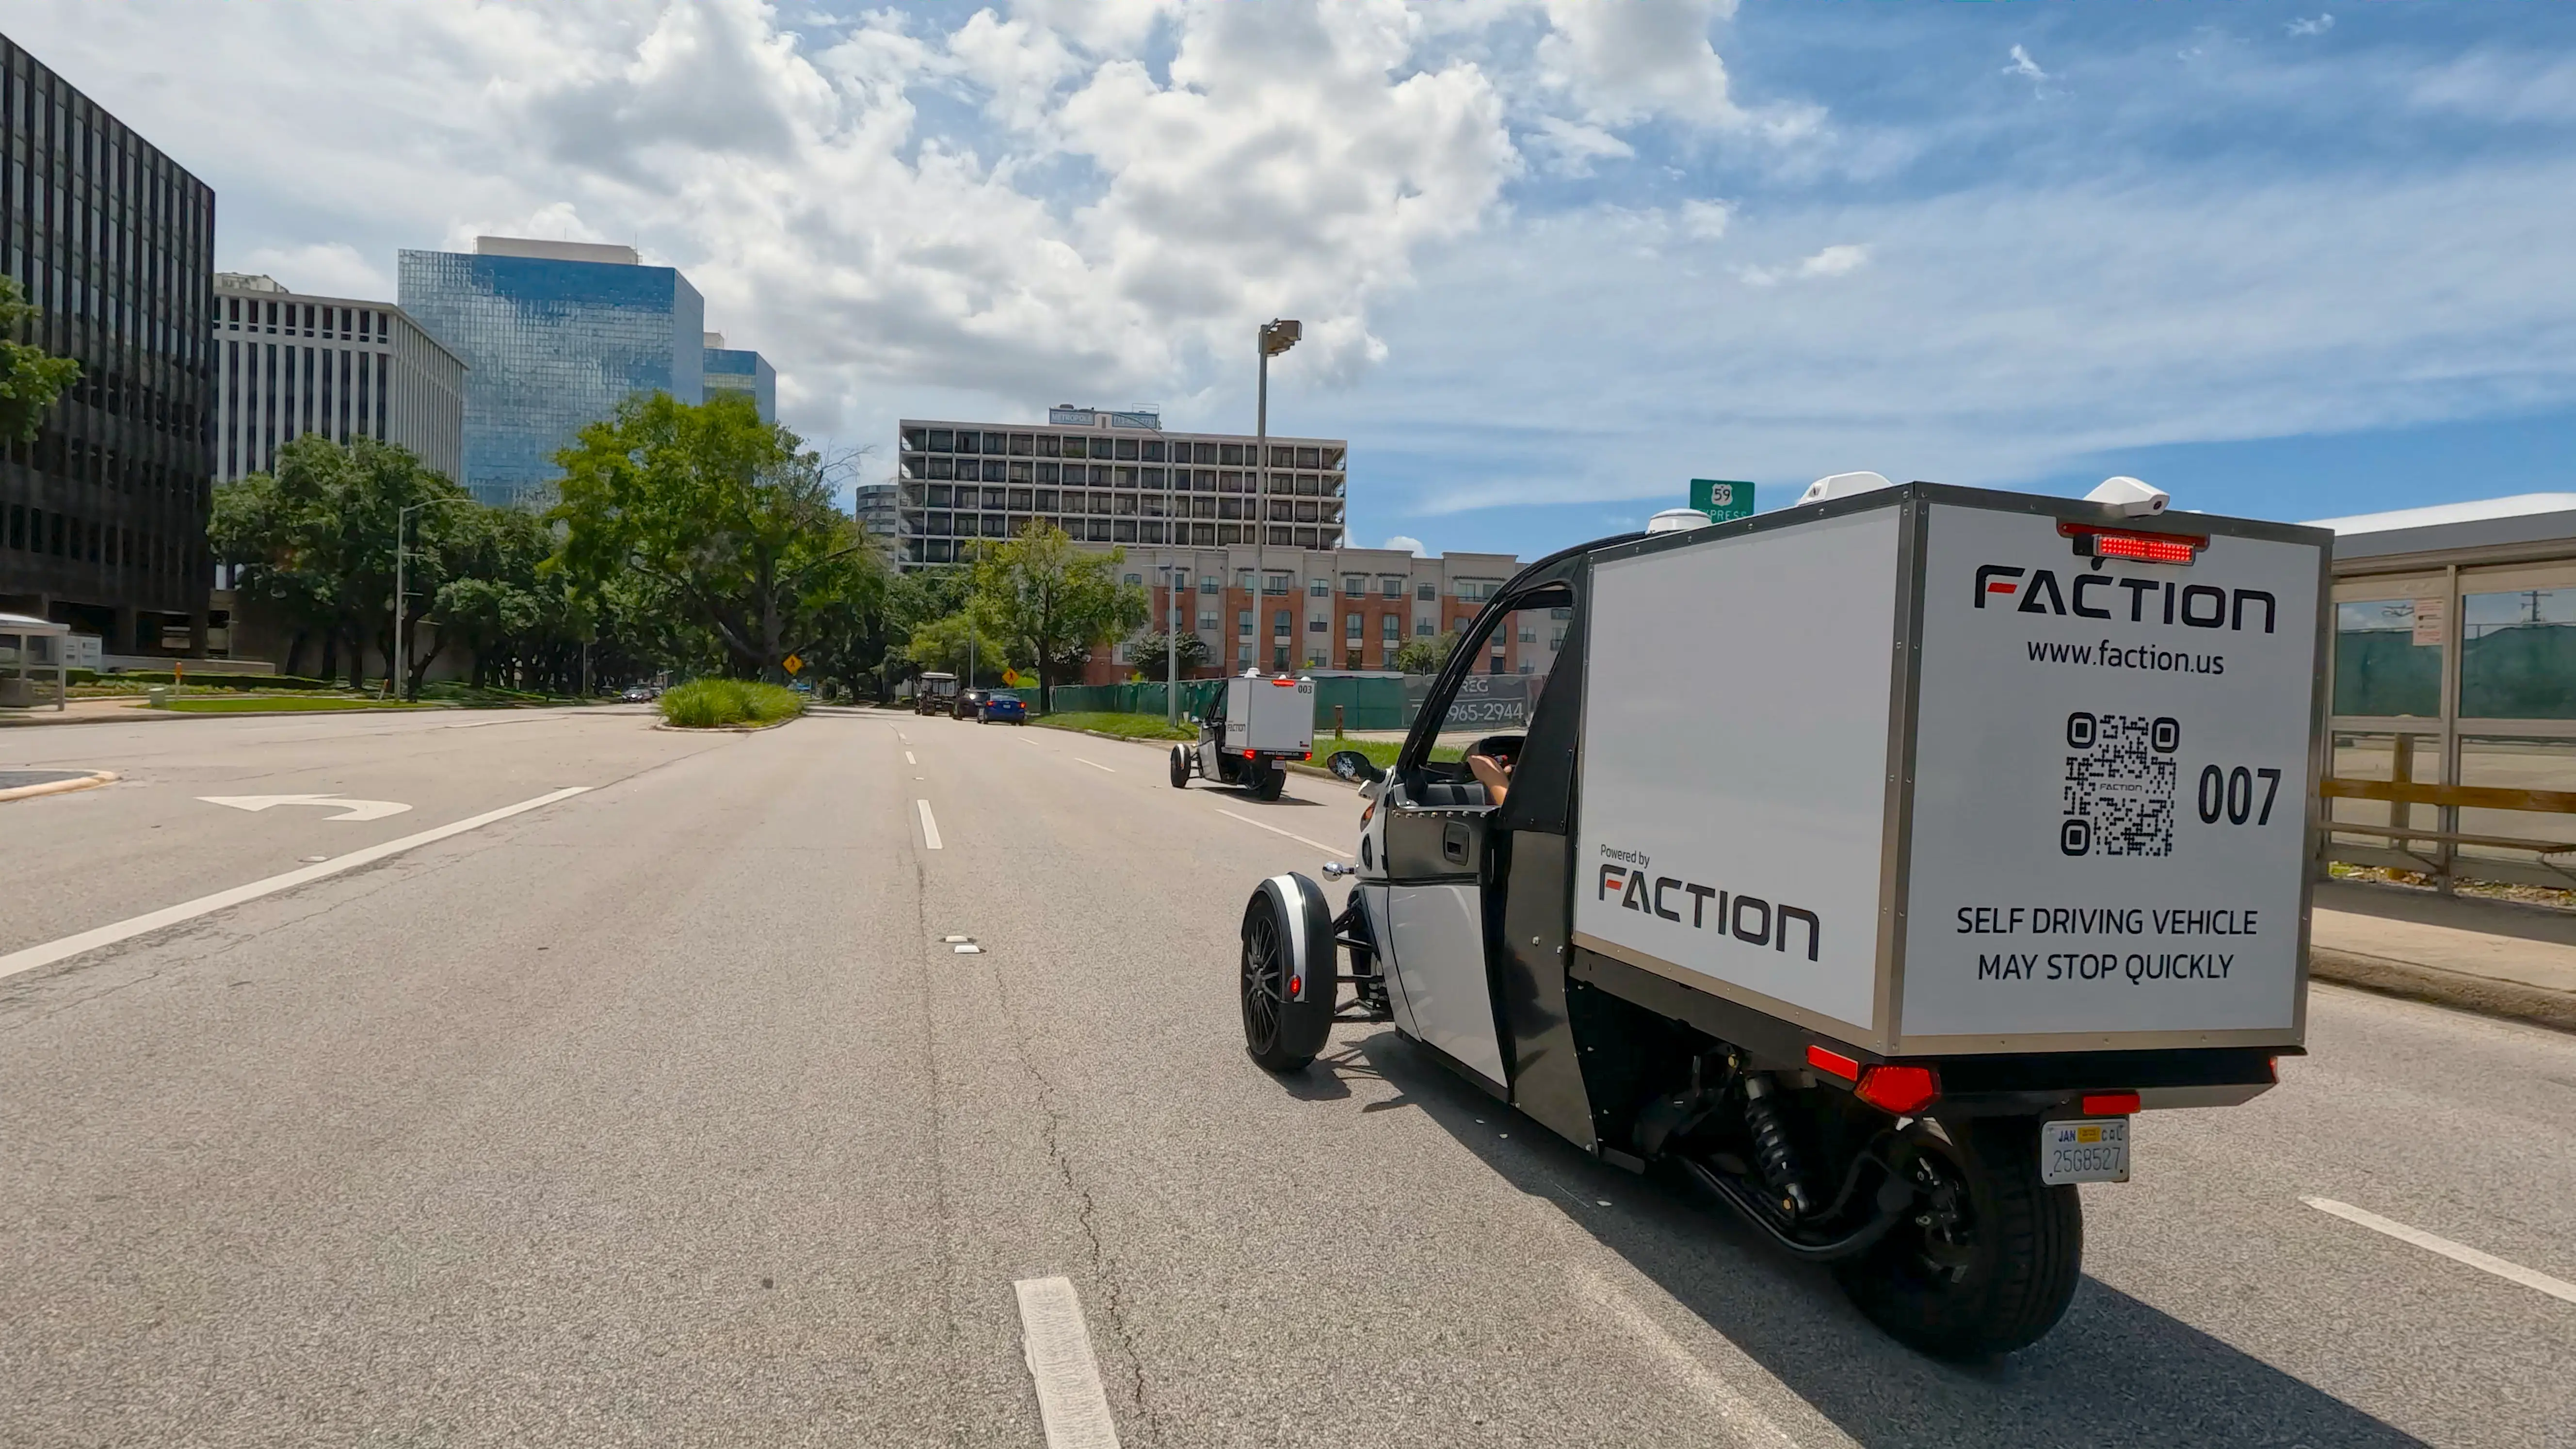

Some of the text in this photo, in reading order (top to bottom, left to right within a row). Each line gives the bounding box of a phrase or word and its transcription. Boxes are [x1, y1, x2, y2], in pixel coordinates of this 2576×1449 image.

[1714, 488, 1730, 501] 59
[1974, 564, 2275, 634] FACTION
[2028, 640, 2224, 675] www.faction.us
[1298, 685, 1312, 694] 003
[2100, 783, 2142, 791] FACTION
[2198, 764, 2281, 826] 007
[1600, 844, 1650, 869] Powered by
[1599, 864, 1820, 962] FACTION
[1957, 907, 2258, 935] SELF DRIVING VEHICLE
[1979, 954, 2234, 985] MAY STOP QUICKLY
[2058, 1129, 2076, 1142] JAN
[2053, 1147, 2121, 1173] 25G8527
